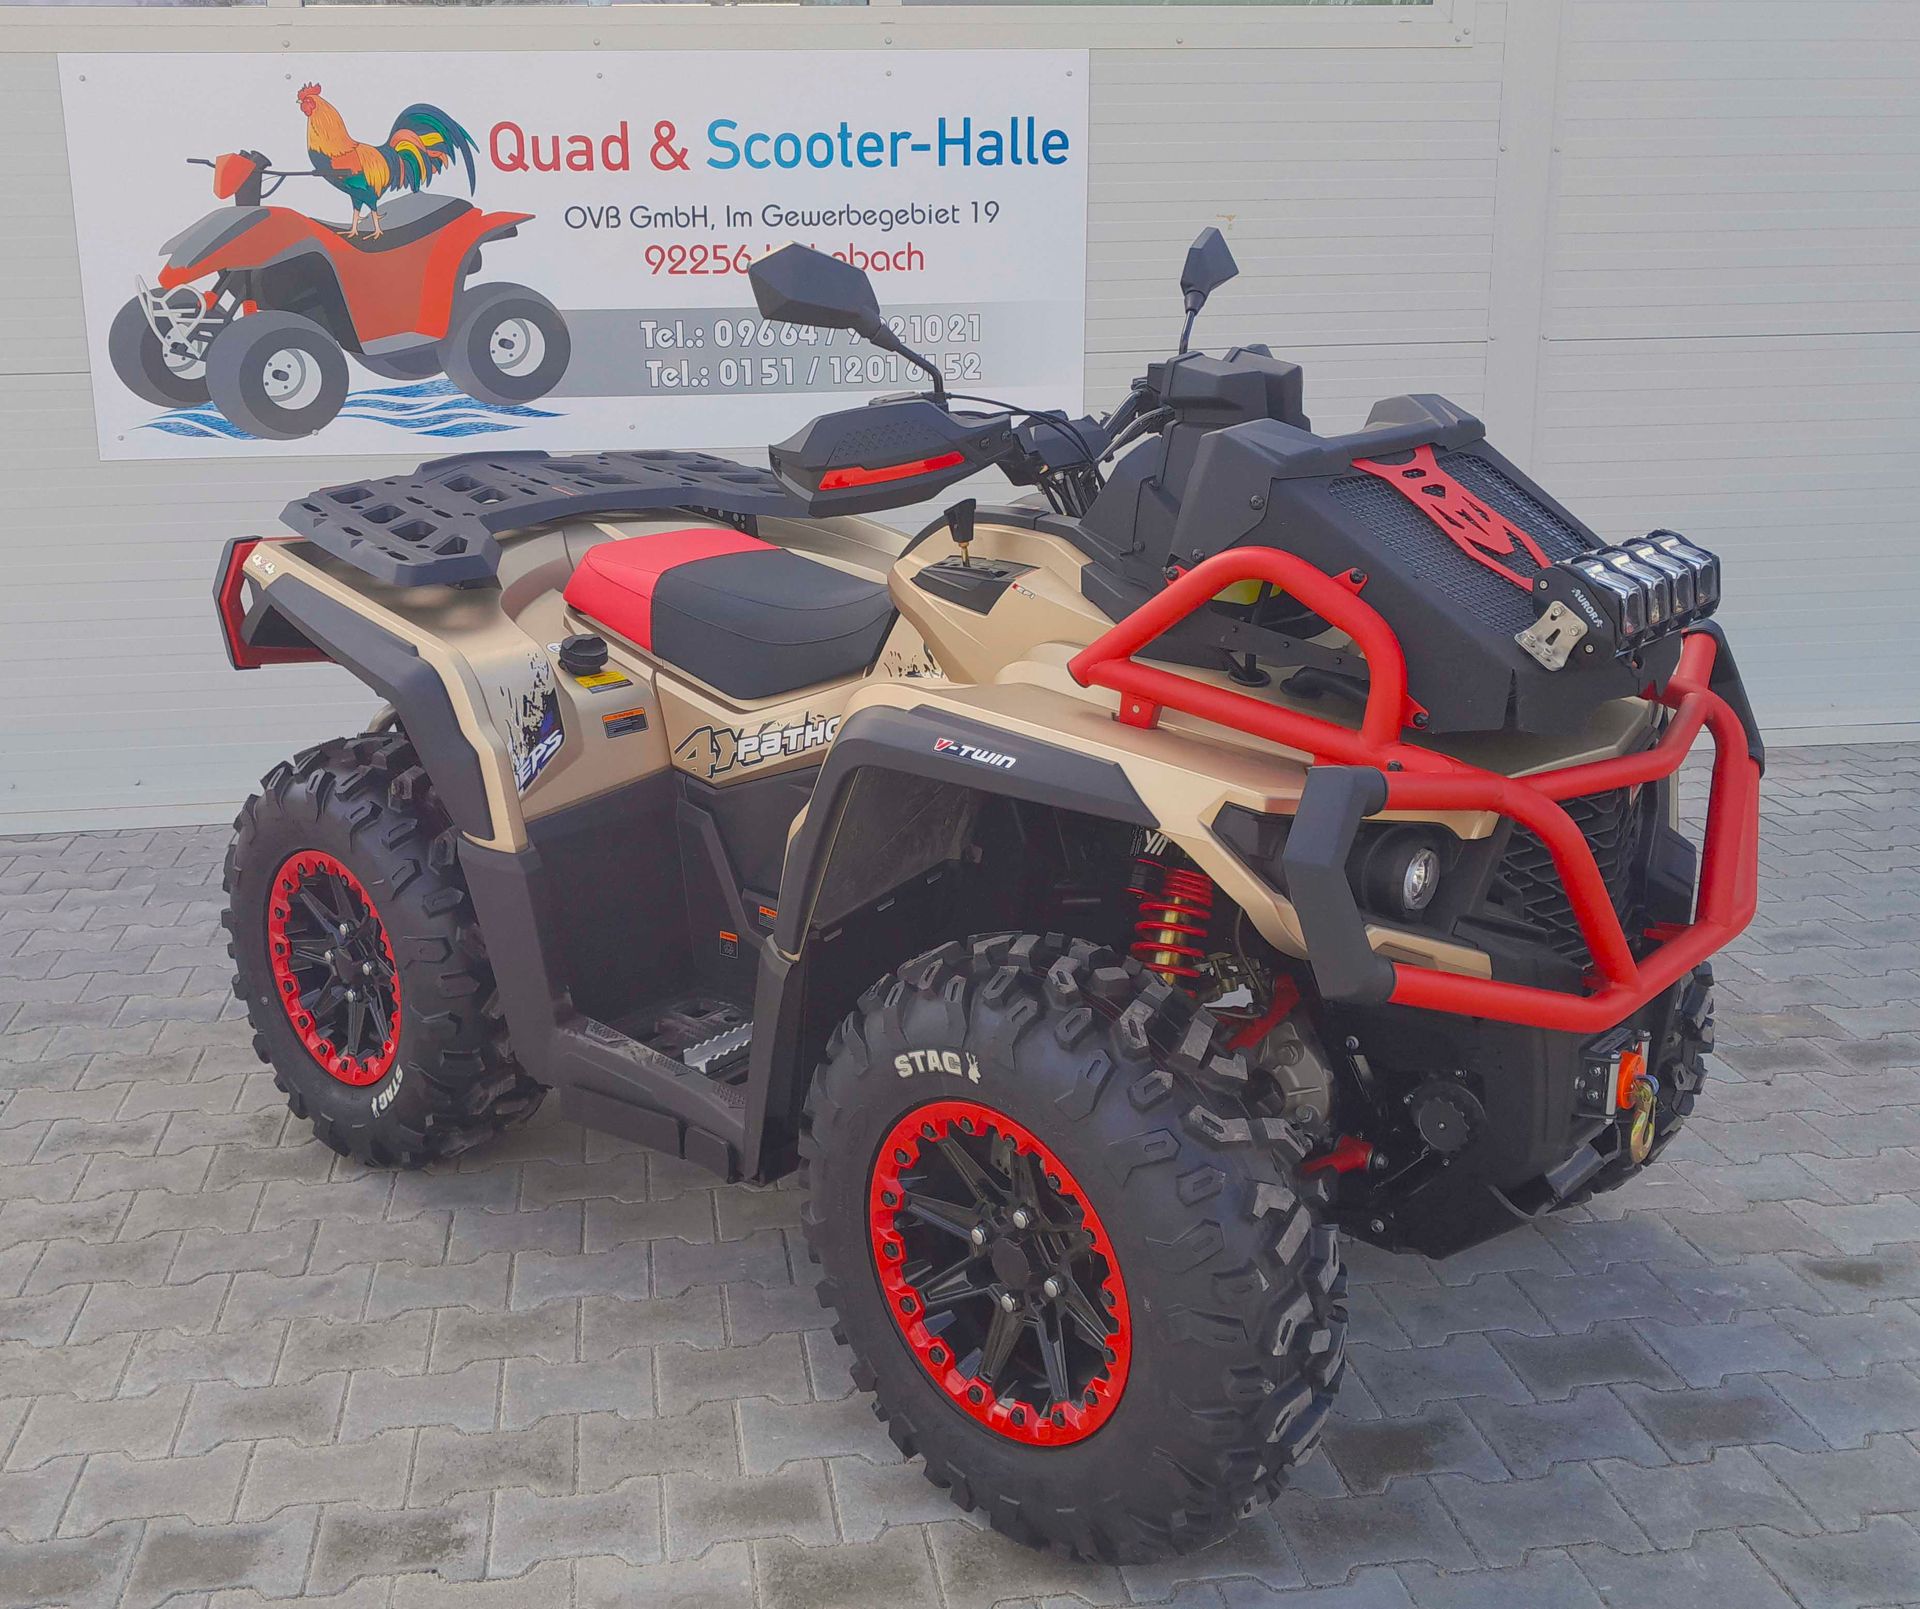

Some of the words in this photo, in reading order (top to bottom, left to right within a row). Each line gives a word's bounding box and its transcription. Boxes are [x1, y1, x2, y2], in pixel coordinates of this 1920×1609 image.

[489, 120, 630, 172] Quad
[649, 119, 691, 171] &
[706, 116, 1070, 169] Scooter-Halle
[629, 204, 715, 230] GmbH,
[726, 204, 752, 228] Im
[761, 202, 960, 232] Gewerbegebiet
[970, 200, 1000, 224] 19
[644, 243, 752, 275] 92256
[765, 241, 925, 273] bach
[640, 319, 704, 350] Tel.:
[645, 358, 710, 389] Tel.:
[1571, 586, 1605, 629] AURORA
[516, 728, 564, 790] EPS
[933, 737, 1017, 769] V-TWIN
[893, 1049, 964, 1079] STAG
